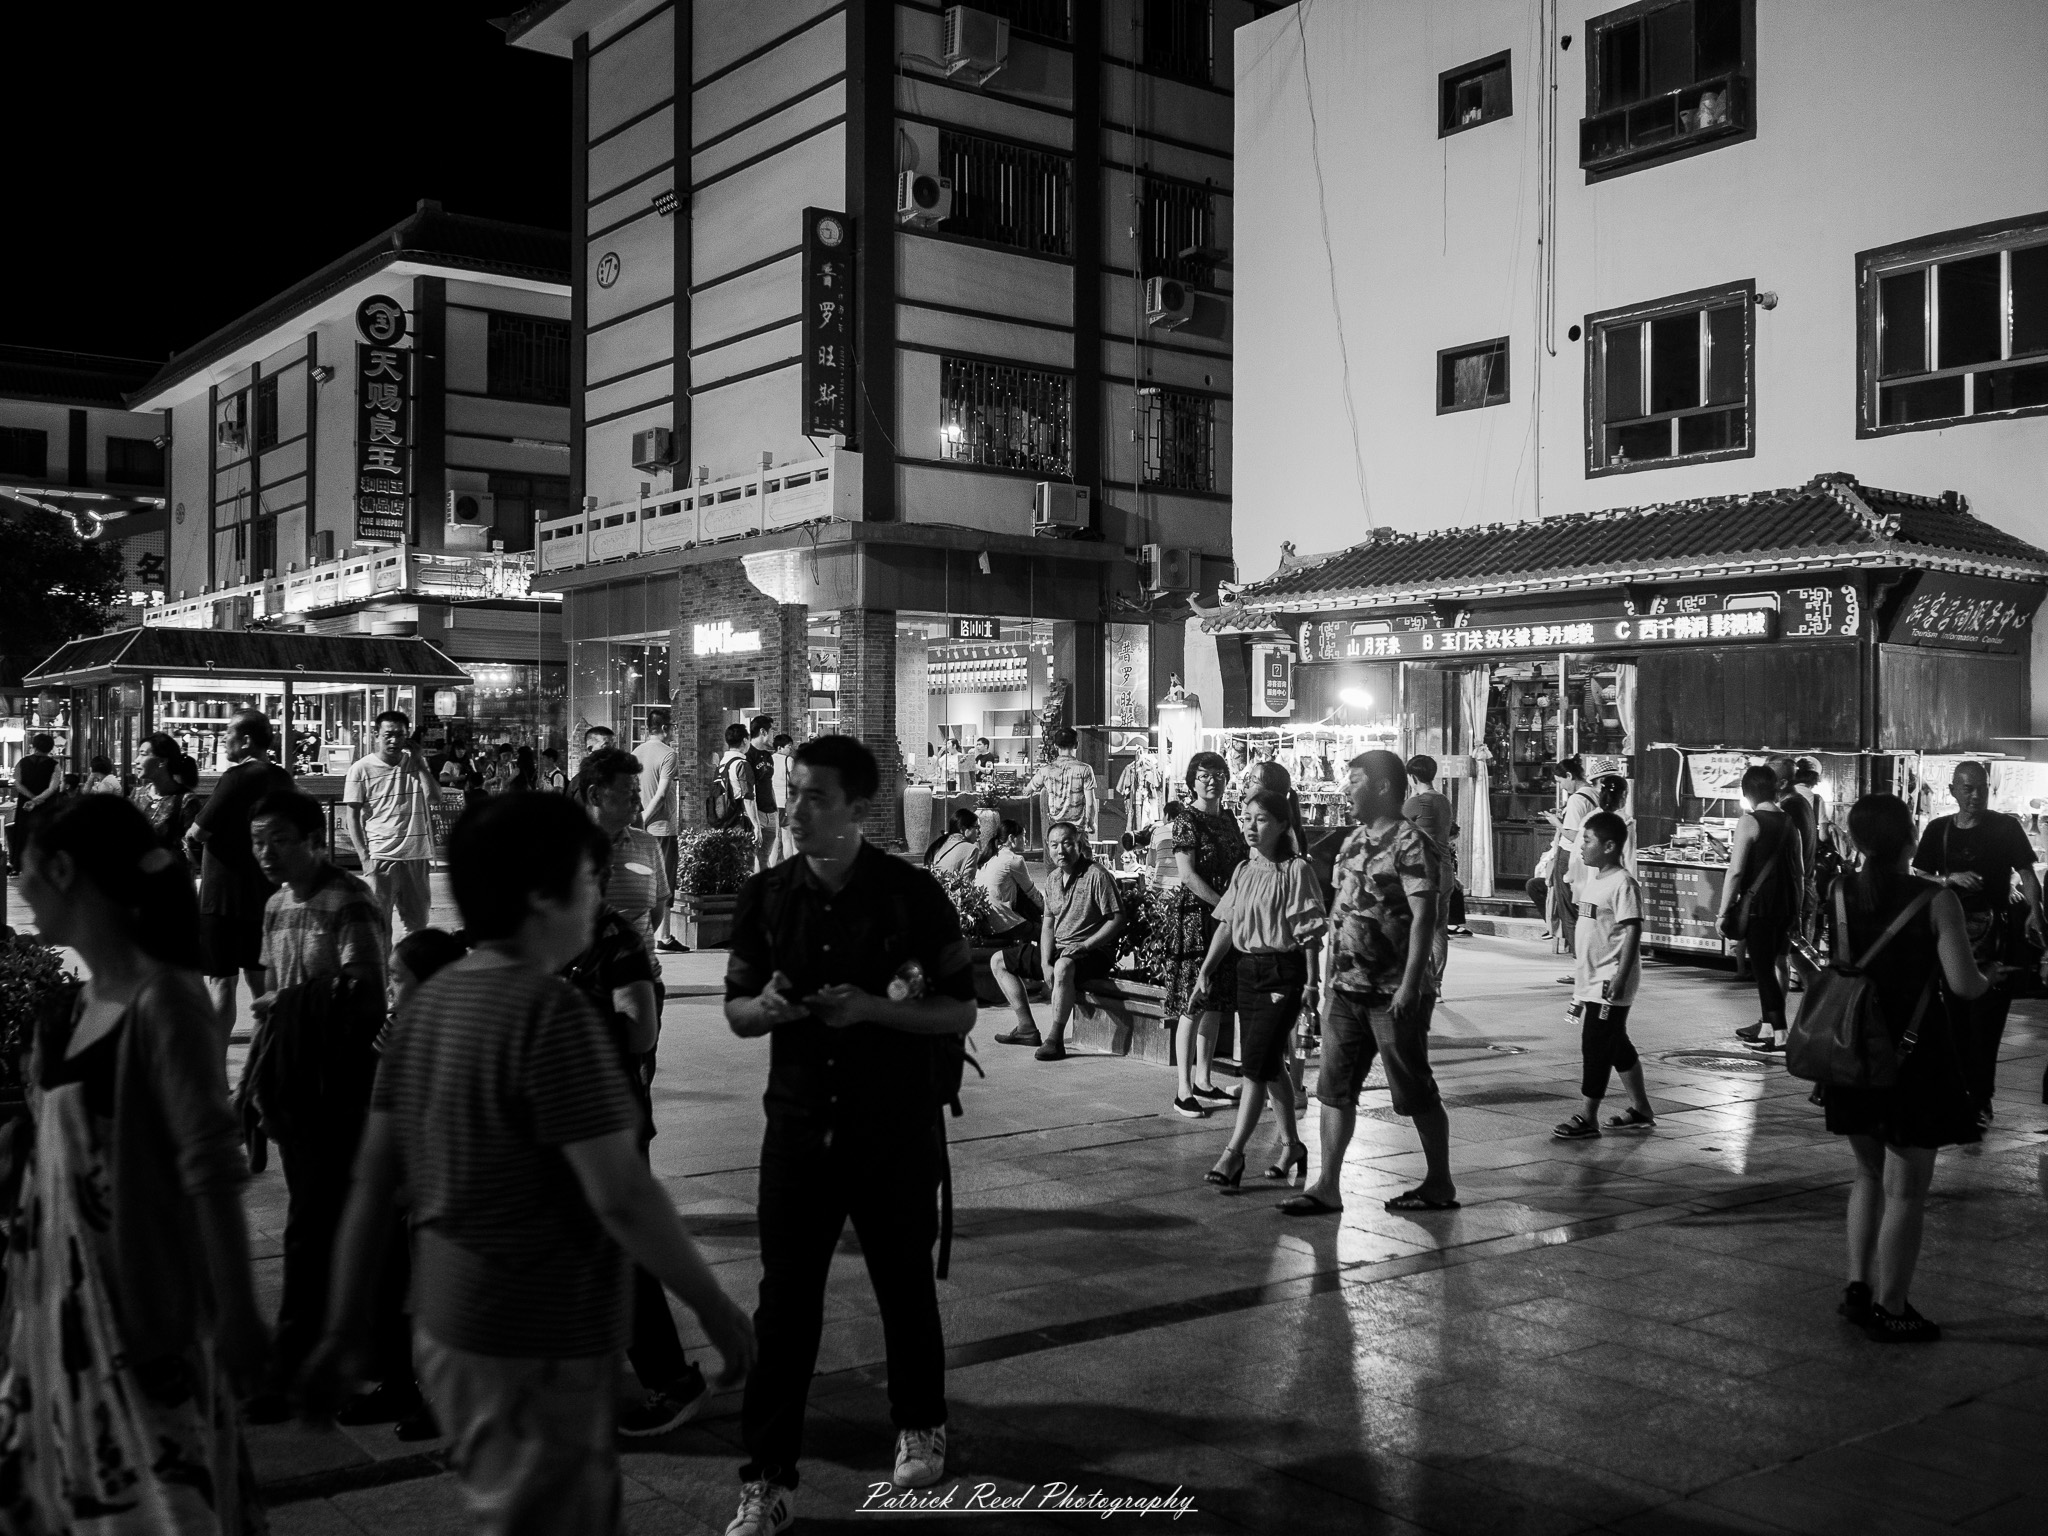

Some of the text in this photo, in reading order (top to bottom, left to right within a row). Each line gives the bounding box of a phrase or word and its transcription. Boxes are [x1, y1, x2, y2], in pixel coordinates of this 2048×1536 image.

[363, 350, 403, 474] 天赐良玉
[360, 476, 404, 495] 和田玉
[360, 496, 404, 516] 精品店
[1423, 634, 1434, 650] B
[1615, 621, 1631, 639] C
[1911, 628, 1938, 639] Tourism
[1941, 631, 1979, 642] Information
